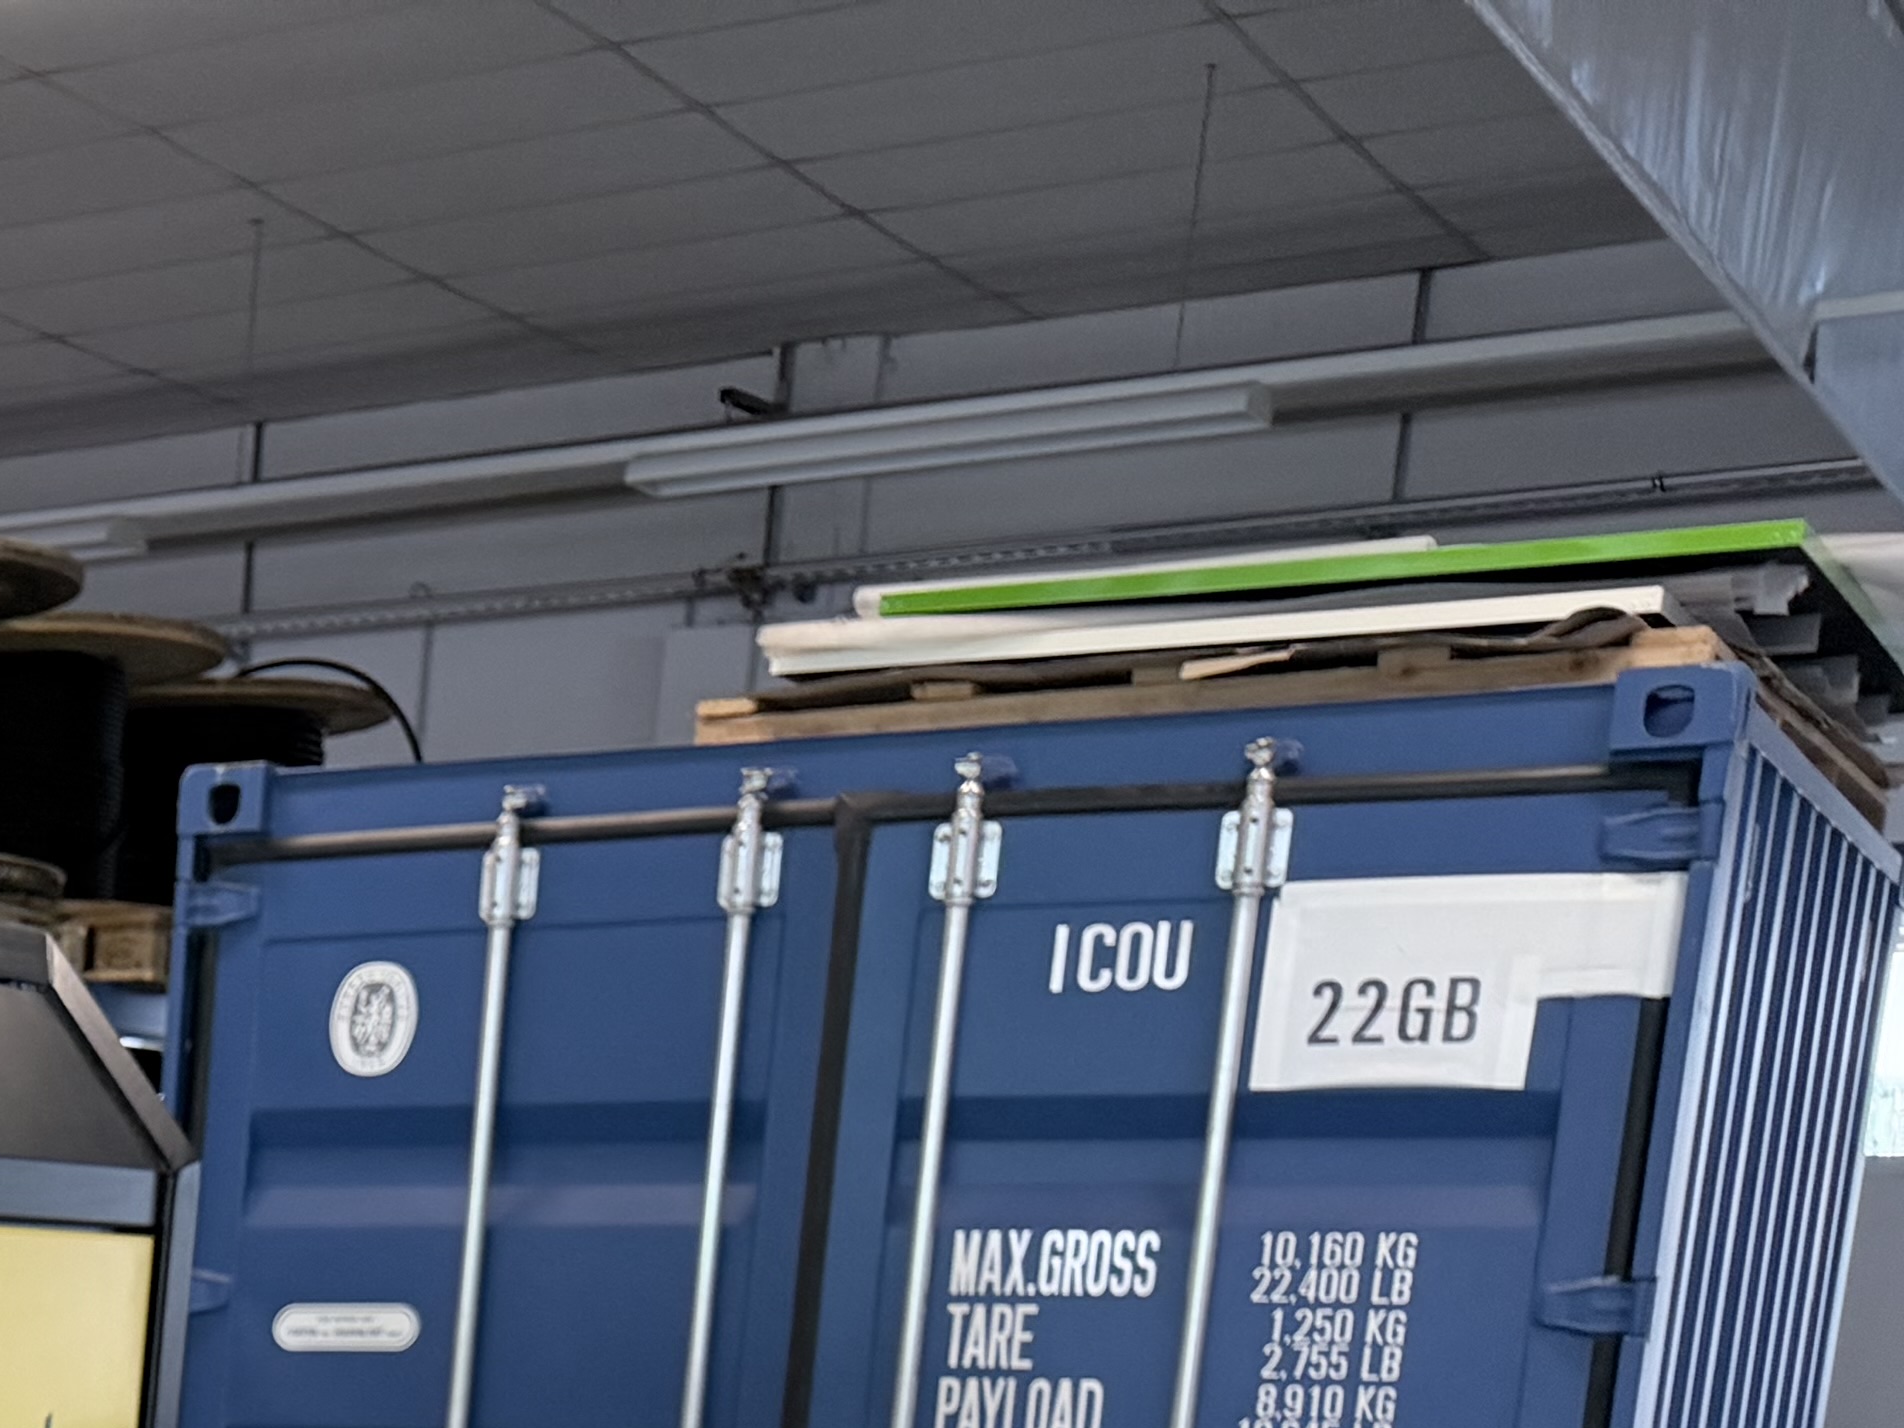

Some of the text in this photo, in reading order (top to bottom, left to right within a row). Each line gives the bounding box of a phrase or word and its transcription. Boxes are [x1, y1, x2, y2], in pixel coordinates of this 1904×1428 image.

[1049, 920, 1193, 994] ICOU
[1307, 977, 1482, 1046] 22GB
[949, 1228, 1161, 1298] MAX.GROSS
[1260, 1230, 1419, 1269] 10,160 KG
[1249, 1266, 1413, 1306] 22,400 LB
[946, 1302, 1040, 1371] TARE
[1271, 1307, 1408, 1347] 1,250 KG
[1260, 1342, 1403, 1382] 2,755 LB
[1255, 1383, 1398, 1422] 8,910 KG
